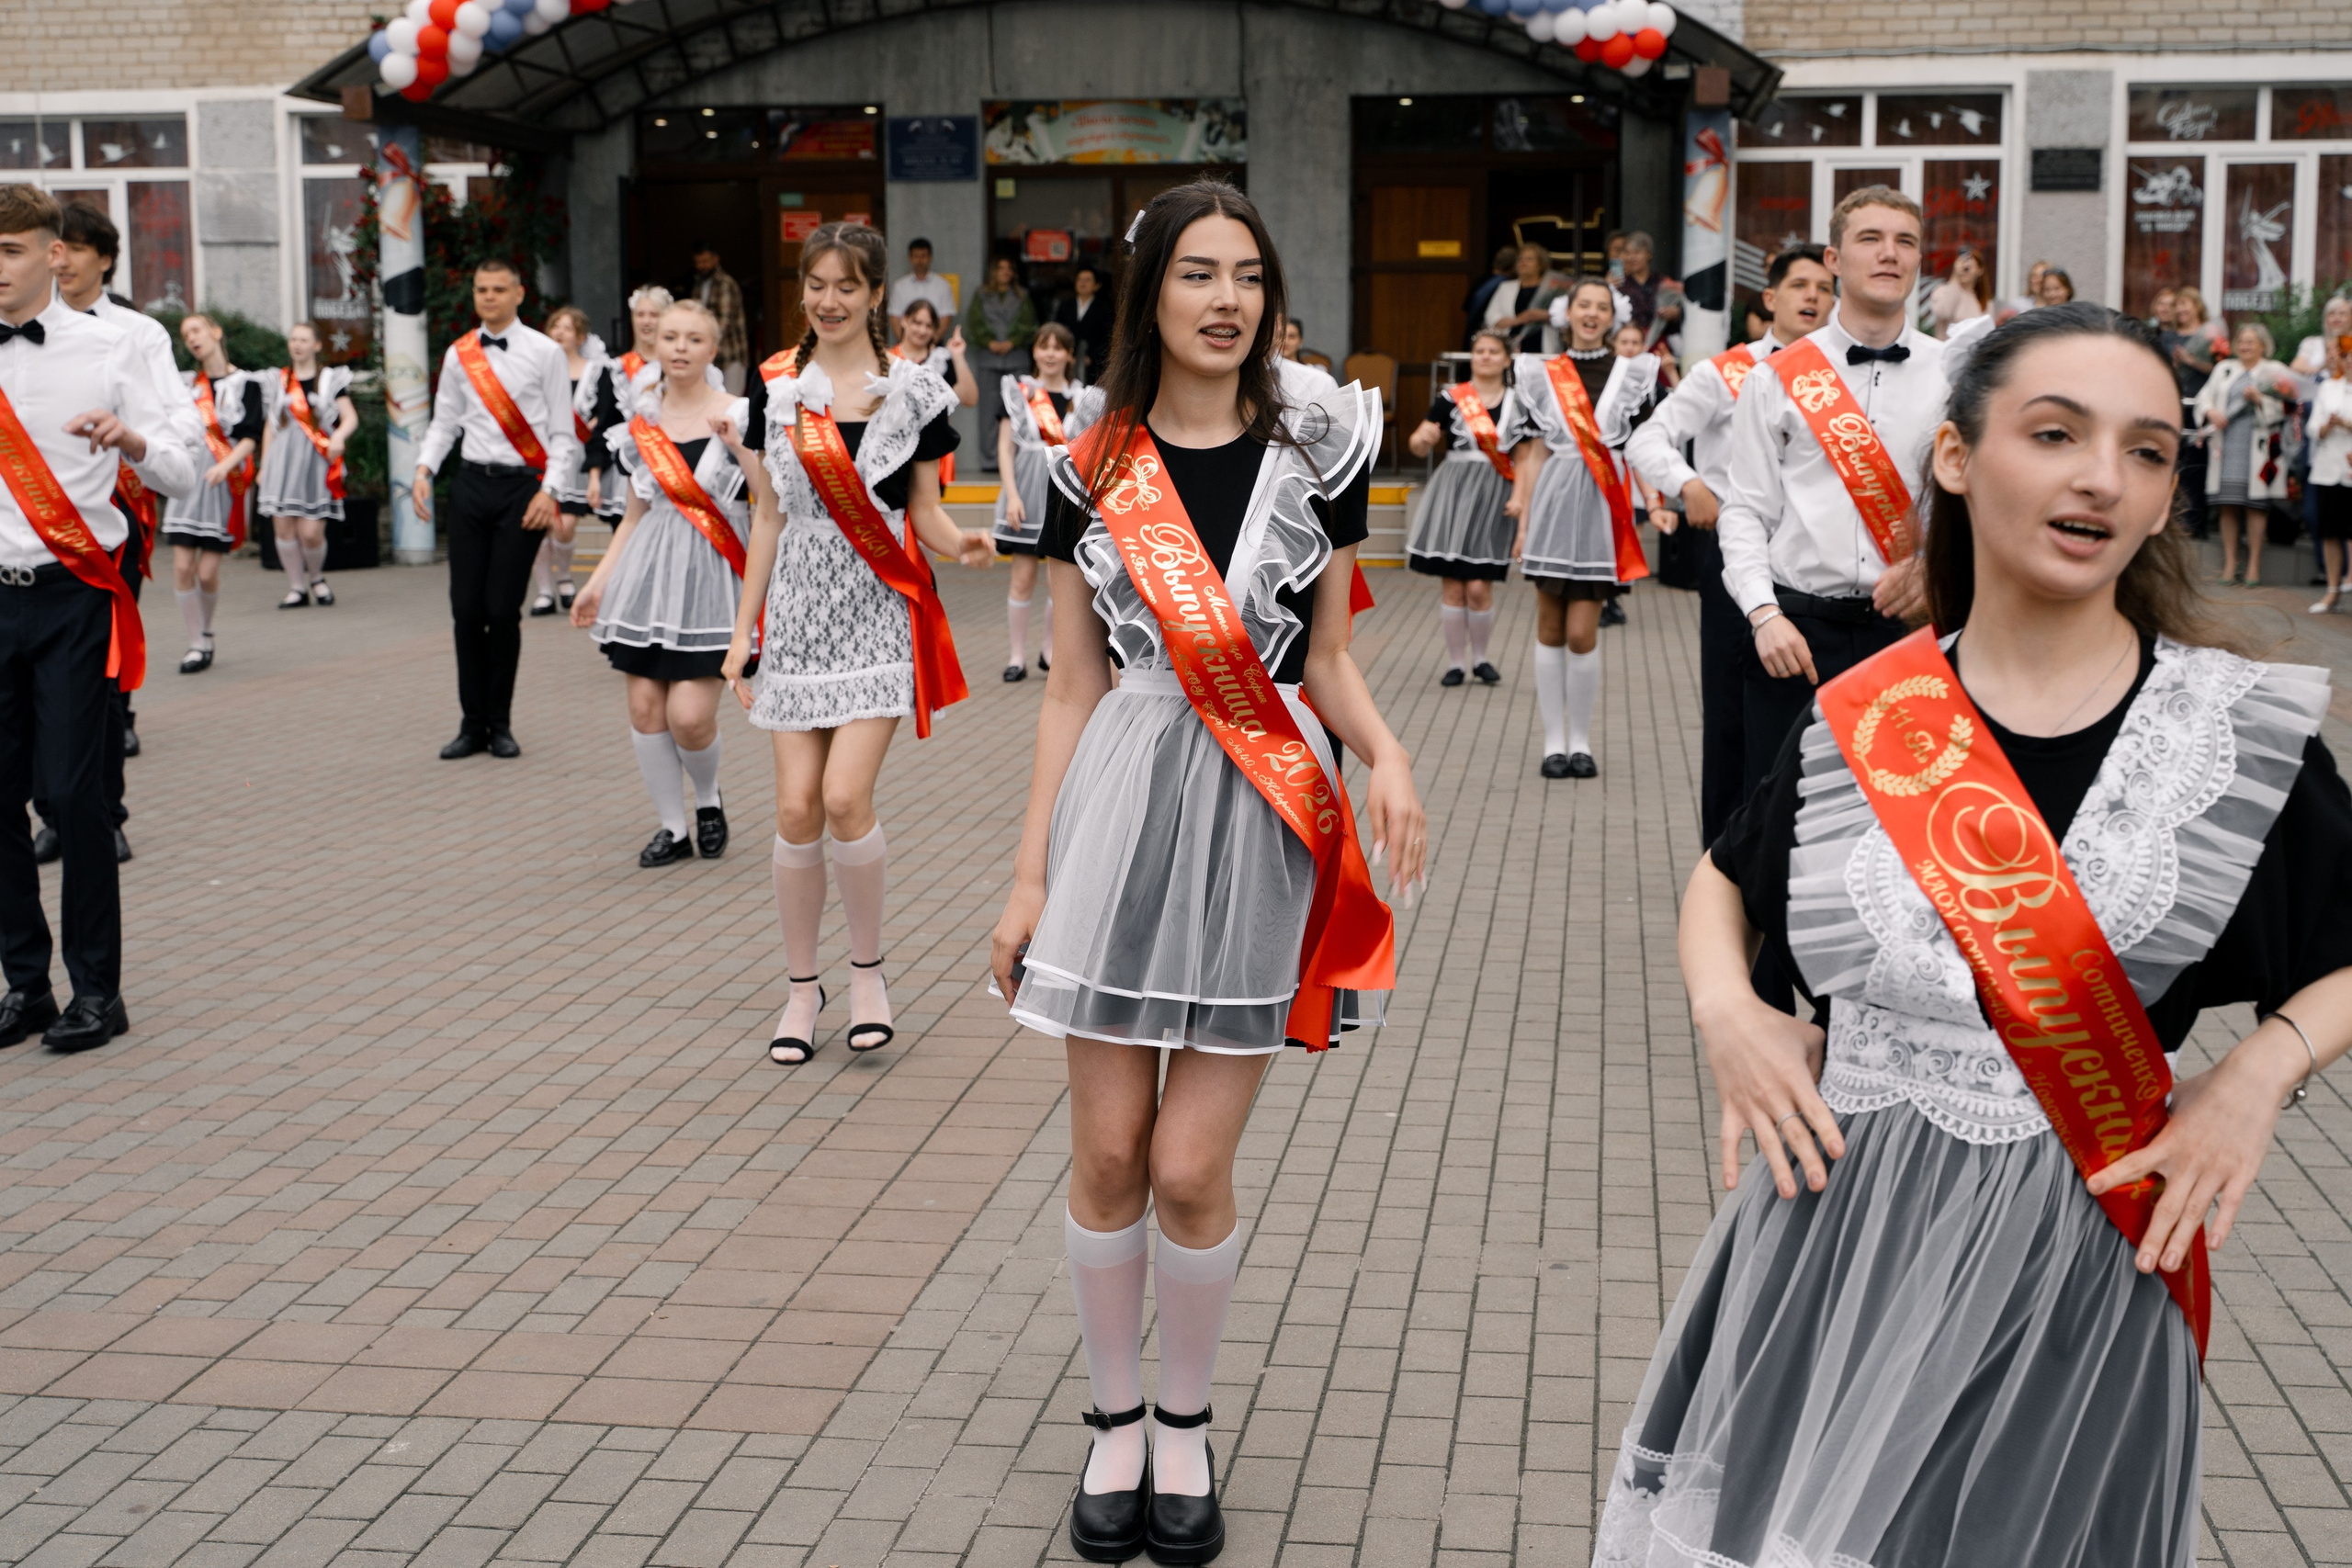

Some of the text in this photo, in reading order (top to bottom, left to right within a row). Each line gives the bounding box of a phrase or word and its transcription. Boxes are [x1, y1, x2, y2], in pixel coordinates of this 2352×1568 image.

[0, 428, 56, 520] пускник
[800, 406, 862, 522] ыпускница
[1122, 536, 1140, 550] 11
[1139, 523, 1340, 834] Выпускница 2026
[1204, 585, 1268, 705] Метелица София
[1890, 706, 1915, 728] 11
[1916, 859, 1967, 927] МАОУ
[1927, 782, 2159, 1200] Выпускни
[2070, 949, 2161, 1101] Сотниченко
